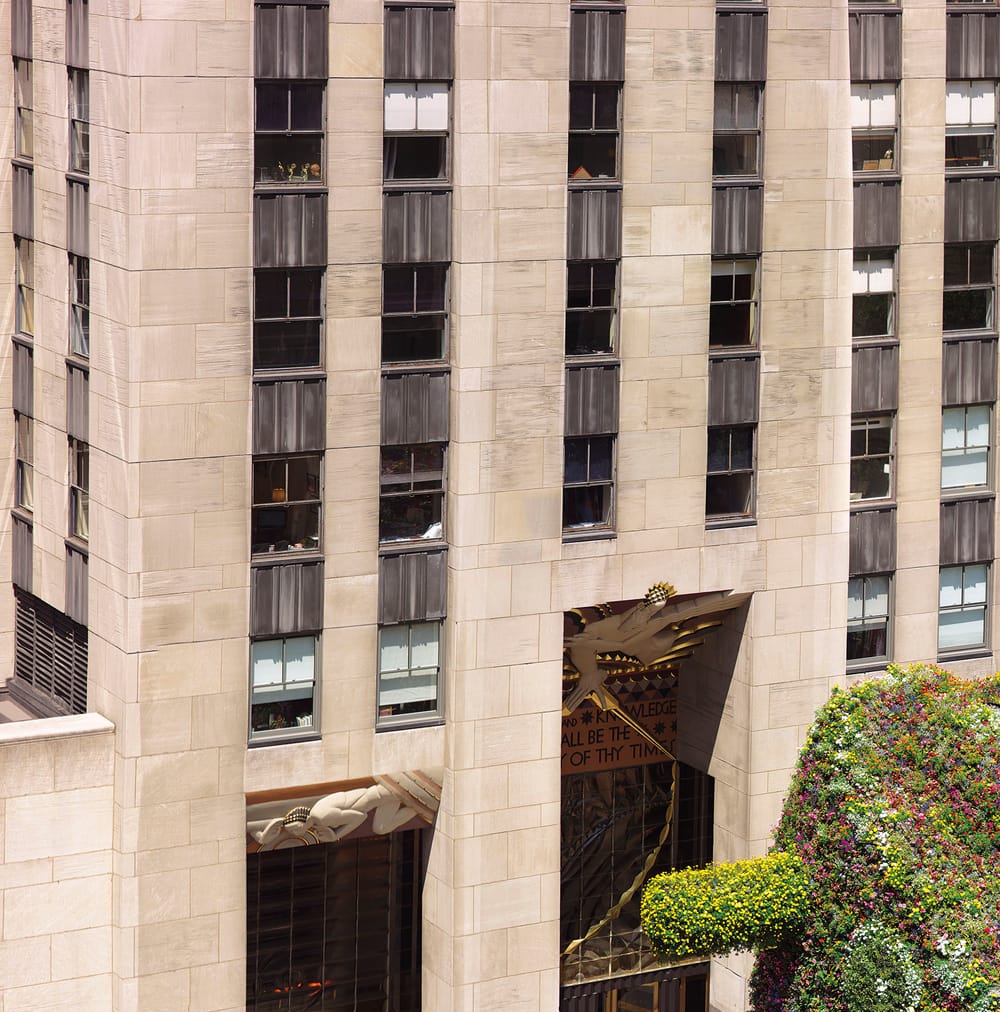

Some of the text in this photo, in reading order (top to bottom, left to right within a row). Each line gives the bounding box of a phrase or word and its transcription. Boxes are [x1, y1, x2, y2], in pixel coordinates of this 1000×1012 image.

[596, 699, 677, 724] KNWLEDGE
[588, 728, 604, 745] BE
[609, 725, 631, 741] THE
[570, 750, 591, 766] OF
[596, 746, 624, 763] THY
